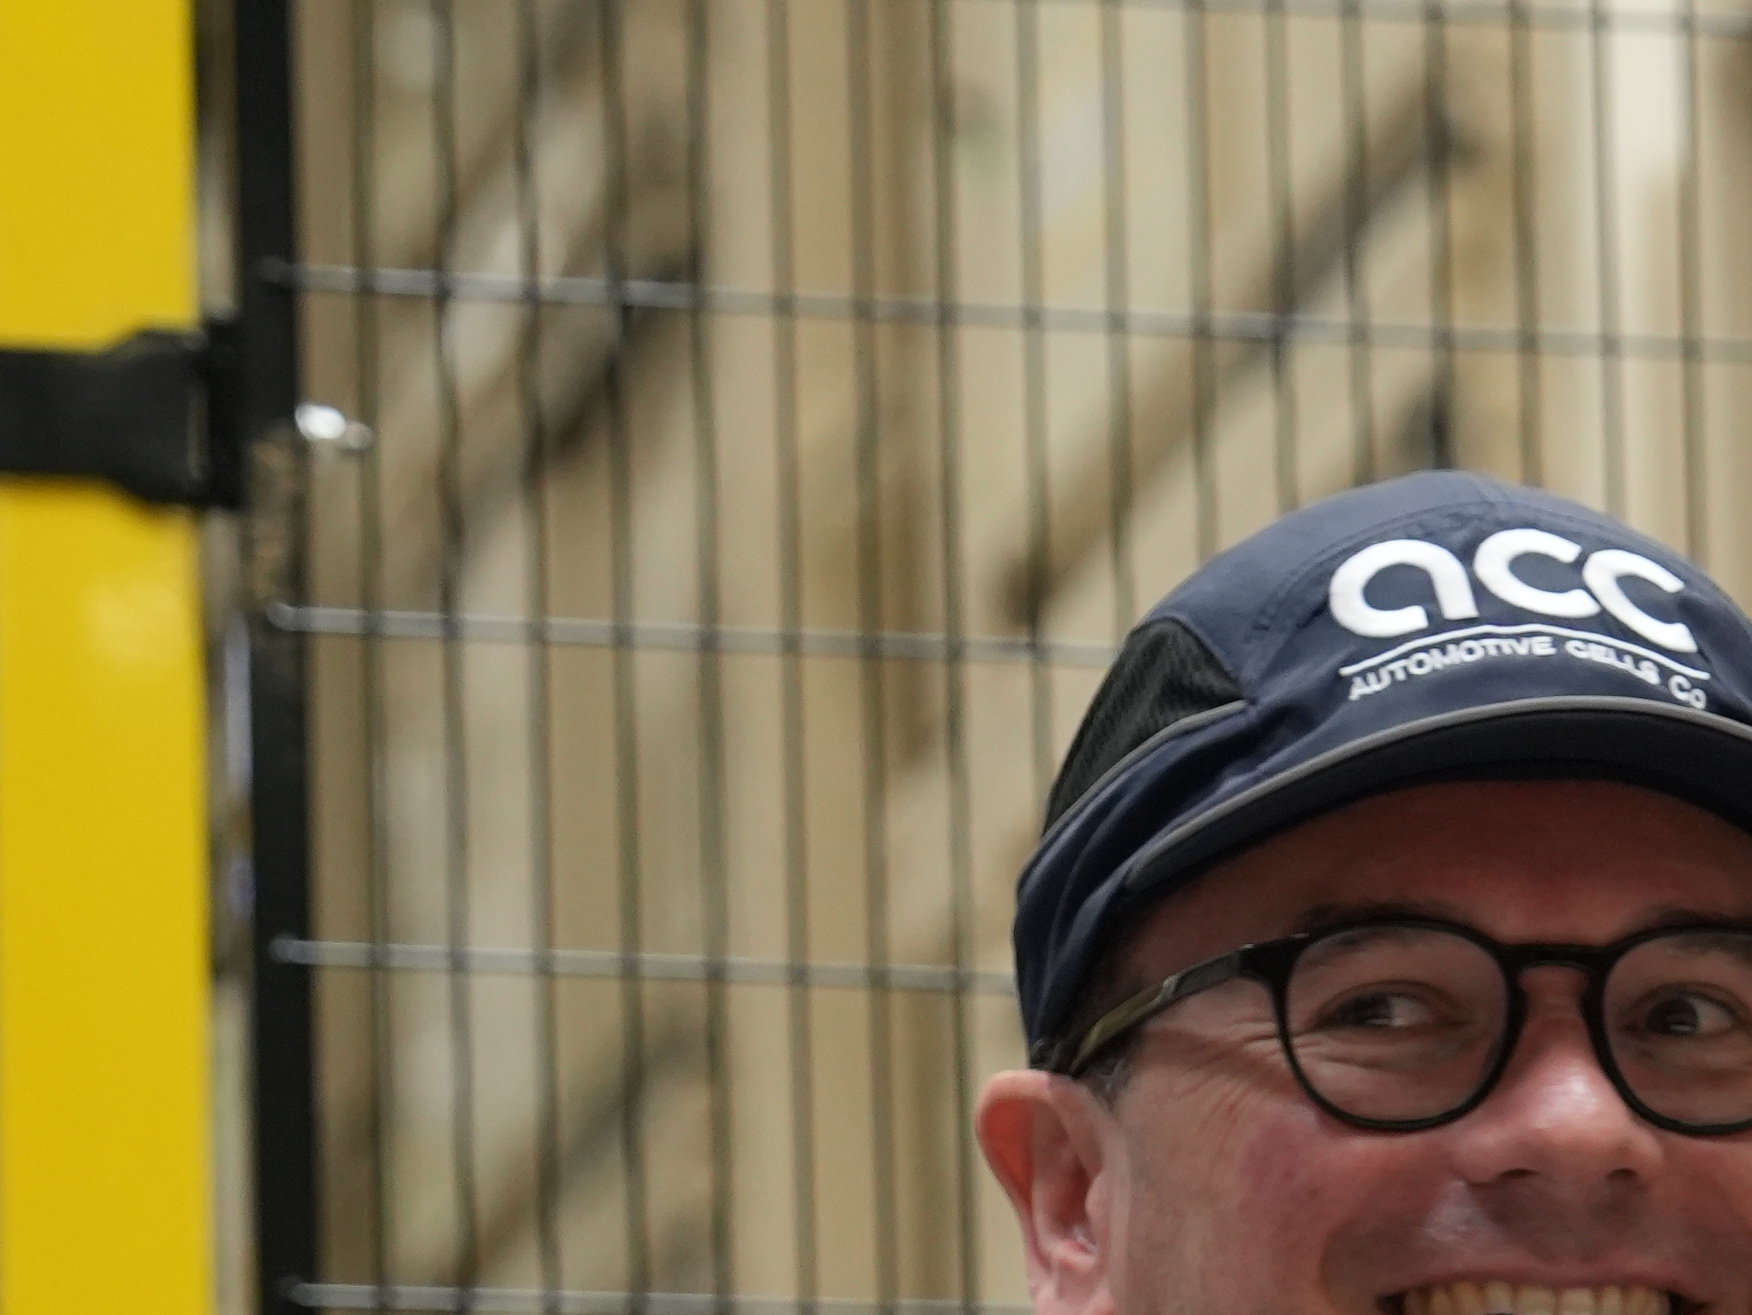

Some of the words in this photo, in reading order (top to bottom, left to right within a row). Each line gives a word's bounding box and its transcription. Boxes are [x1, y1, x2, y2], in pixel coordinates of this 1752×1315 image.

[1329, 528, 1699, 653] acc
[1348, 636, 1556, 700] AUTOMOTIVE
[1564, 639, 1659, 685] CELLS
[1668, 674, 1707, 709] Co
